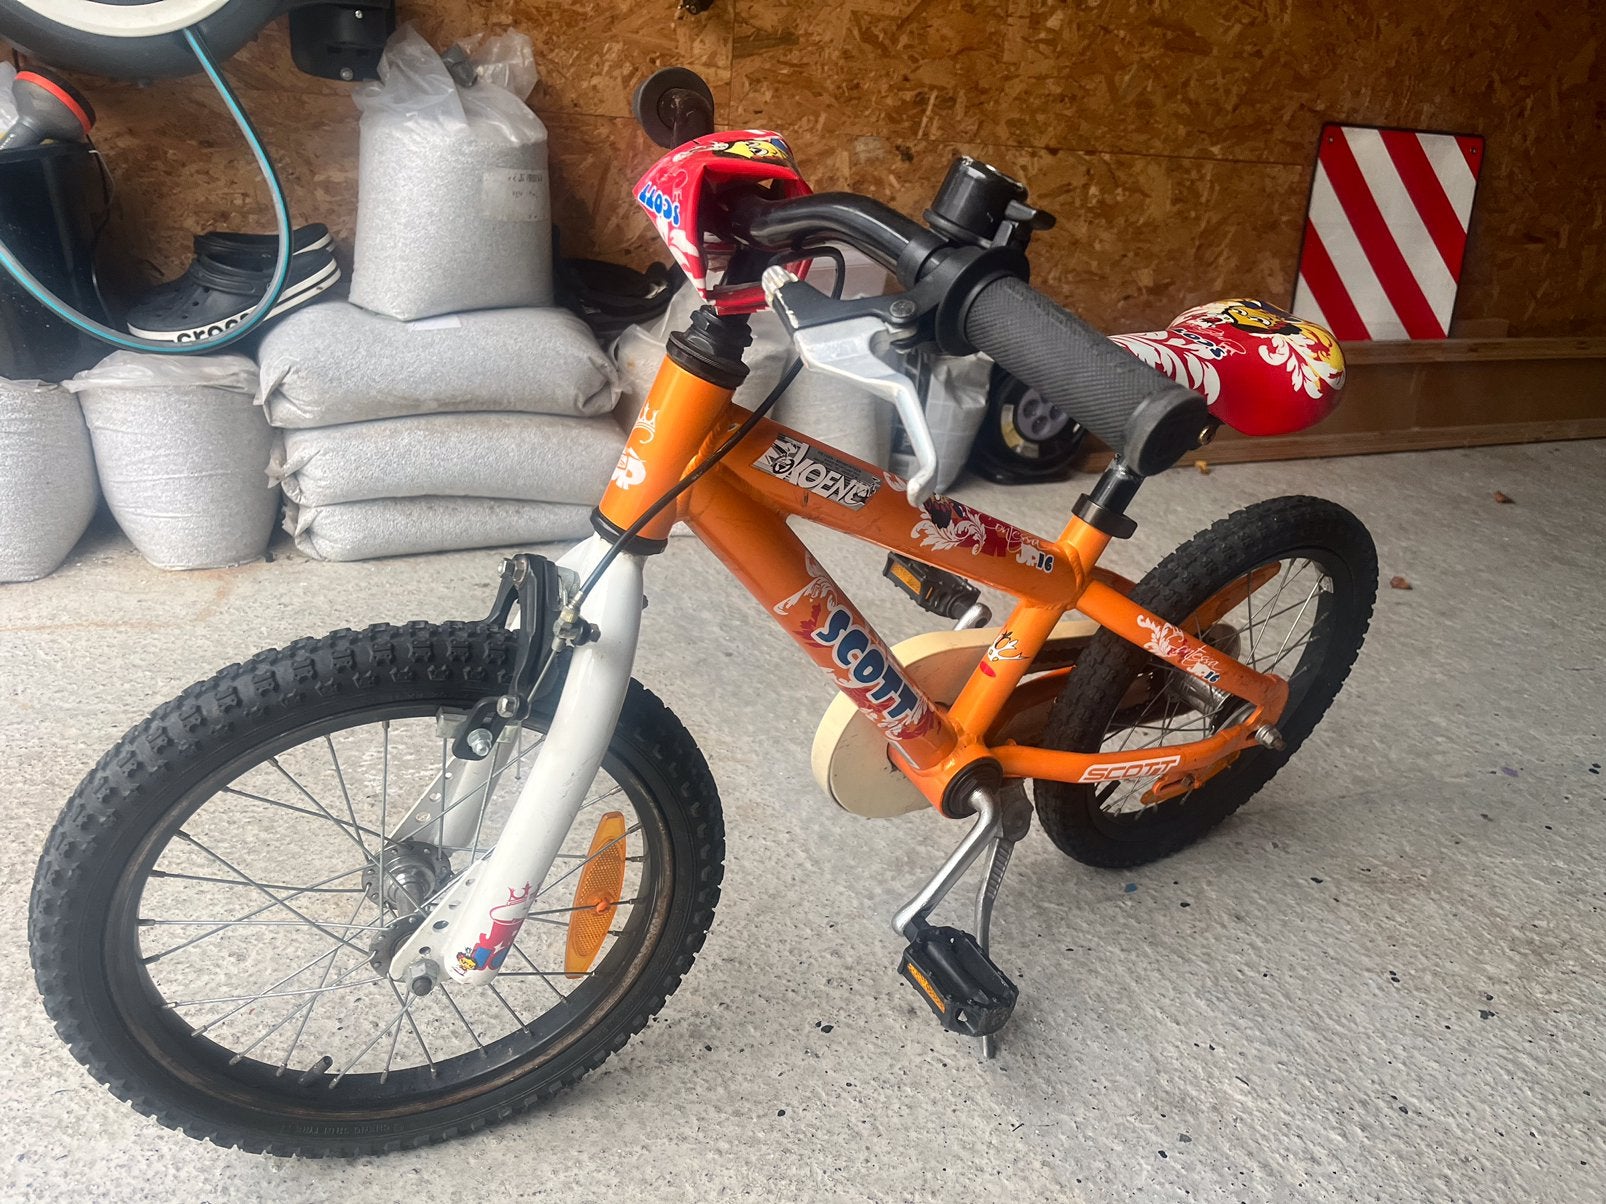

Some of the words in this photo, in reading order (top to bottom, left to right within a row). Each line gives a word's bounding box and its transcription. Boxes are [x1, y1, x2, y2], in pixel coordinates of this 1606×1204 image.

[638, 181, 681, 228] SCOTT
[812, 605, 920, 721] SCOTT
[1081, 757, 1179, 782] SCOTT
